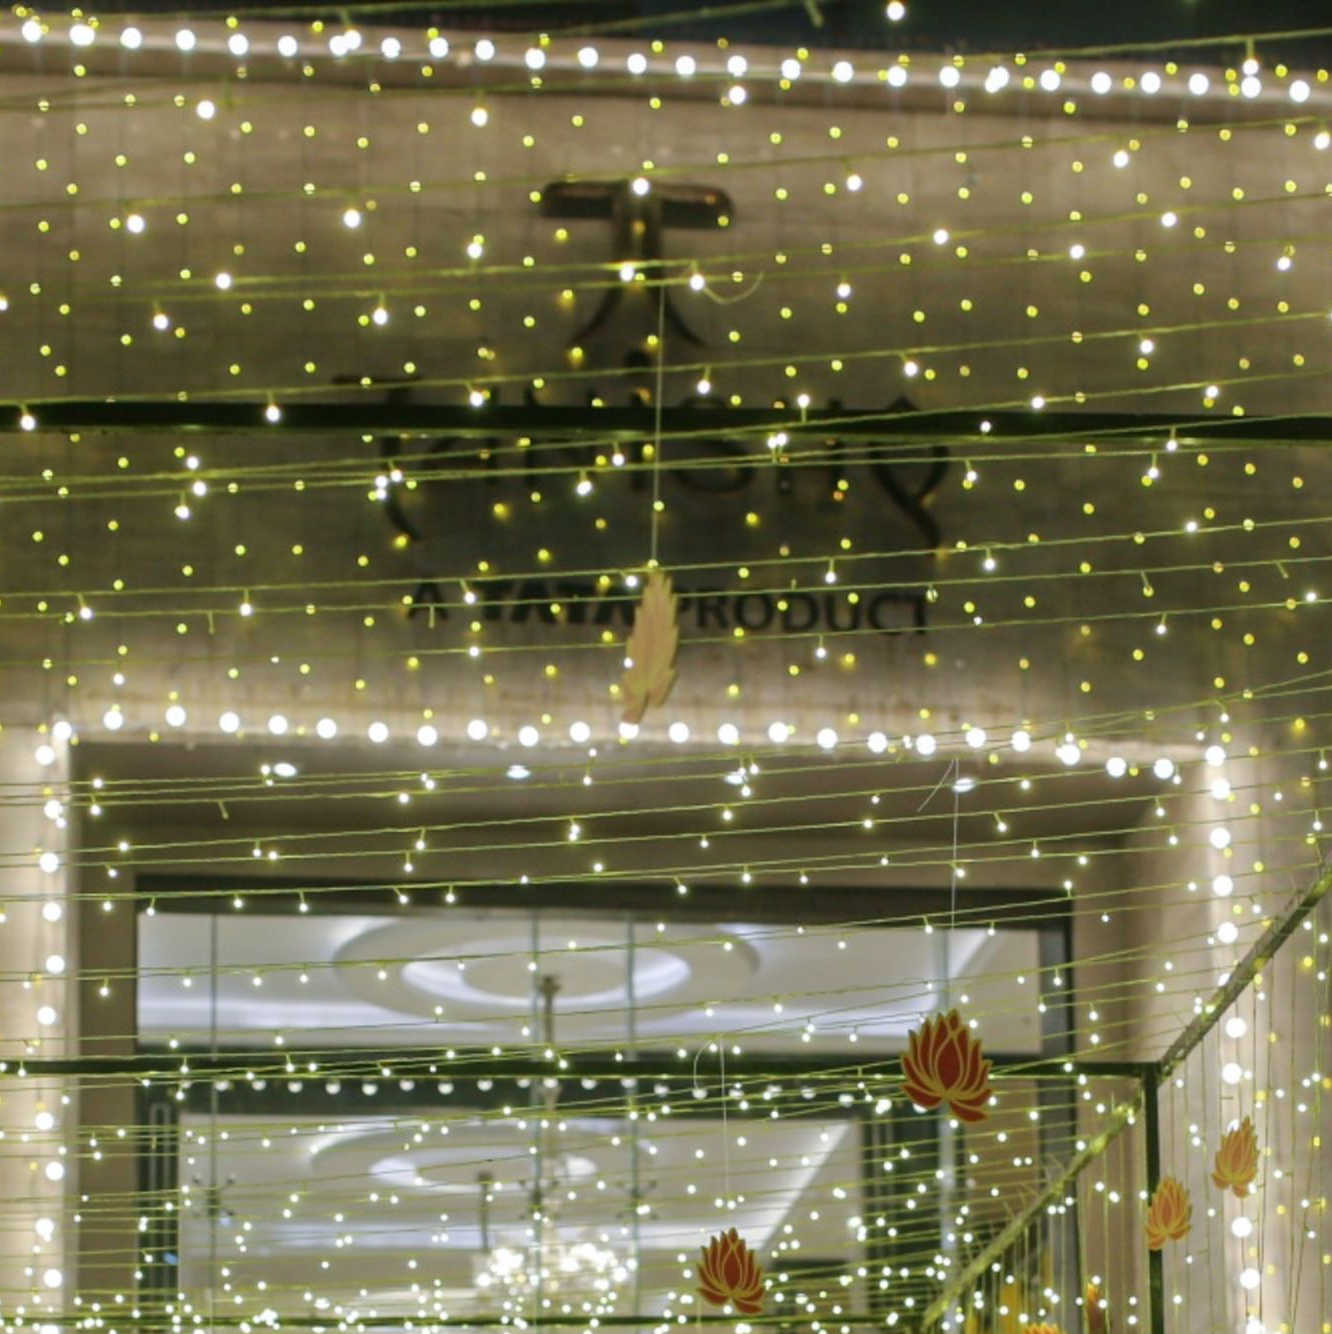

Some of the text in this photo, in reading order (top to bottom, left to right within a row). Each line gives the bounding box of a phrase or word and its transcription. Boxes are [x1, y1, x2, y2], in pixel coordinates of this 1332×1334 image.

[407, 578, 930, 636] A TATA PRODUCT
